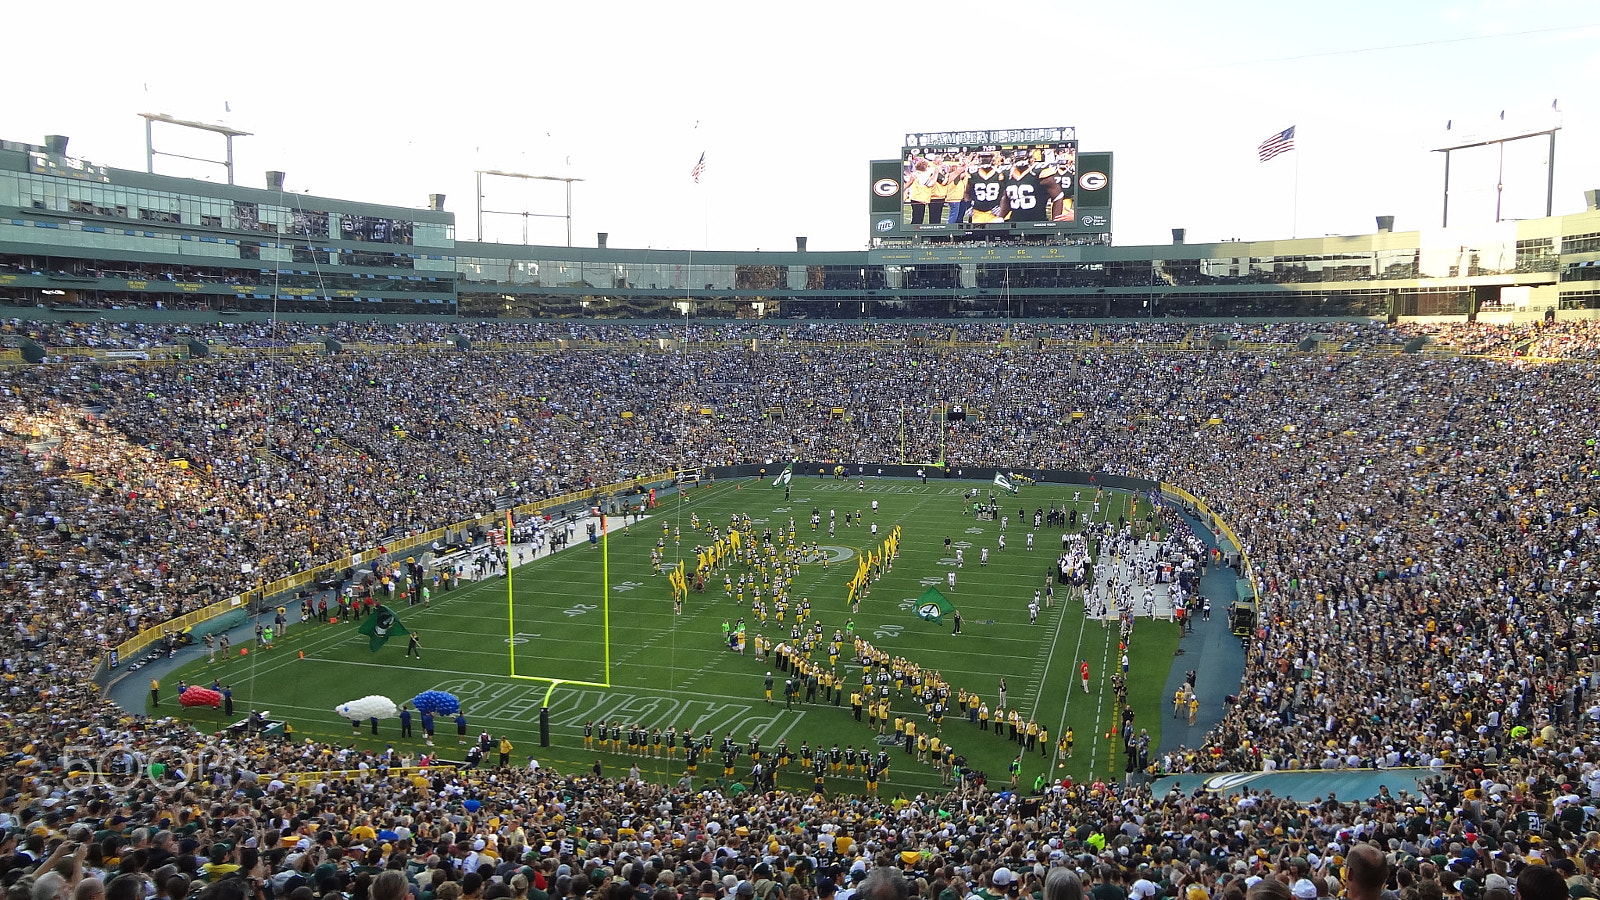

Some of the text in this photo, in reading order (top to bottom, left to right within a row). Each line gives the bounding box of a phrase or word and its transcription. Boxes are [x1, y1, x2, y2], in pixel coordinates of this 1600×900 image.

[927, 129, 1053, 145] LAMBEAU FIELD
[974, 183, 1000, 201] 68
[1006, 185, 1036, 210] 96
[953, 405, 962, 413] 25
[1529, 816, 1540, 831] 21
[819, 857, 830, 868] 12
